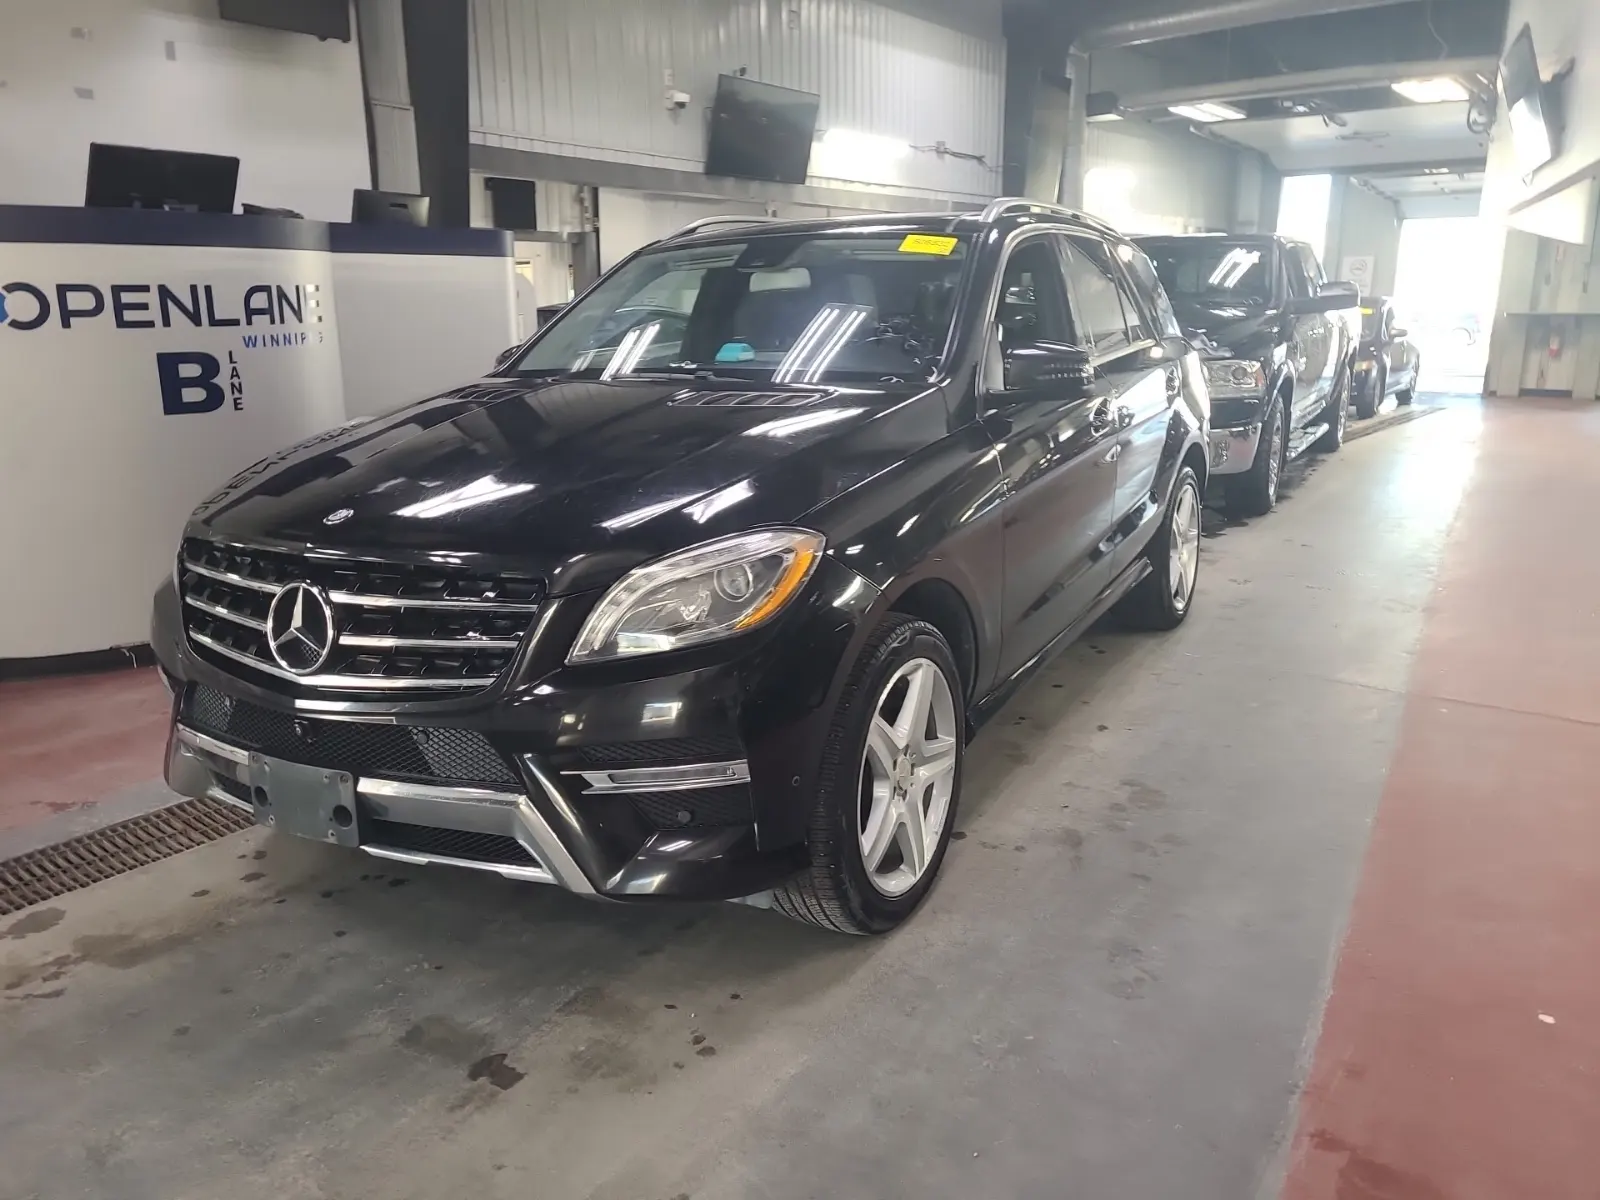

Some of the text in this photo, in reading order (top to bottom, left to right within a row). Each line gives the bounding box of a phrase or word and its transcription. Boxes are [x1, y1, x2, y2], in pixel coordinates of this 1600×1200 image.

[241, 331, 323, 348] WINNIP
[156, 351, 225, 415] B
[228, 350, 244, 411] LANE
